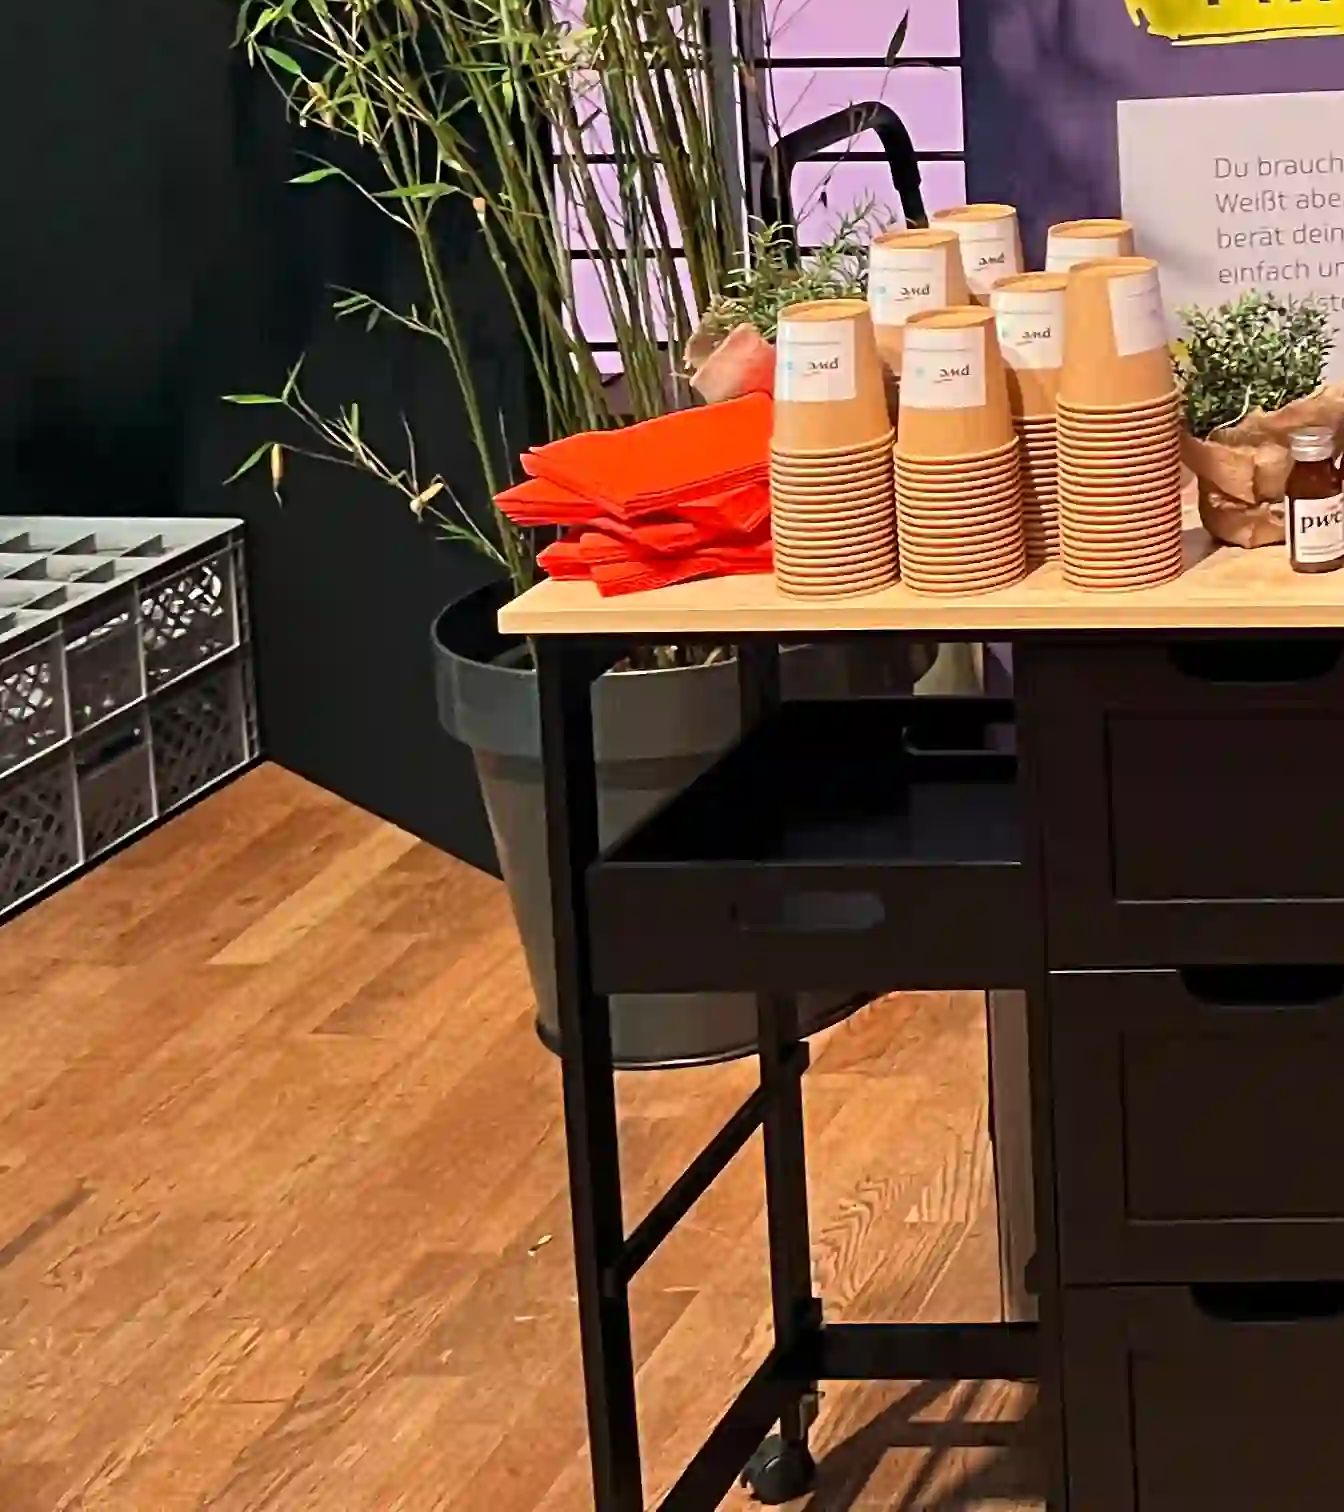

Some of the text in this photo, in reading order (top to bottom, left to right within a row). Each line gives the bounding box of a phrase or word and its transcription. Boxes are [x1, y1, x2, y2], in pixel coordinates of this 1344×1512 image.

[1214, 157, 1249, 180] Du
[1215, 190, 1288, 214] Weißt
[1217, 224, 1284, 249] berät
[1292, 222, 1344, 245] dein
[1219, 259, 1310, 285] einfach
